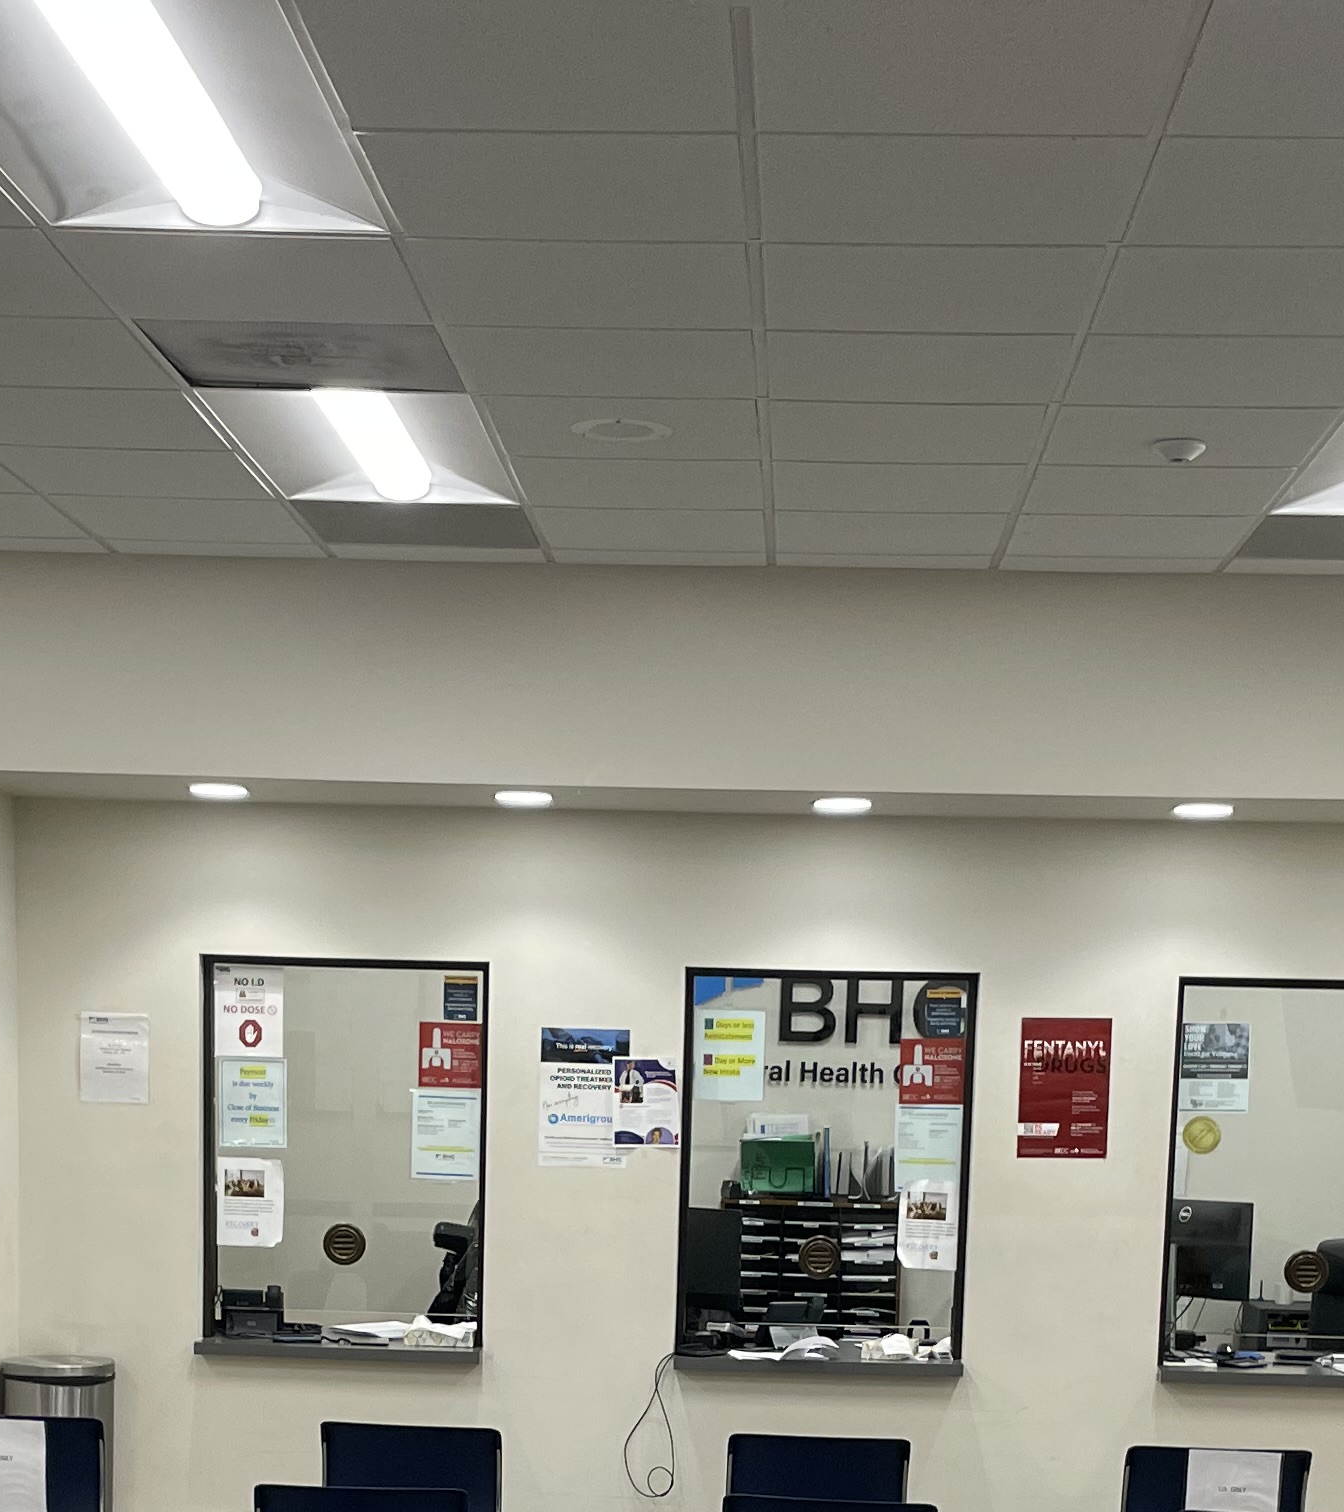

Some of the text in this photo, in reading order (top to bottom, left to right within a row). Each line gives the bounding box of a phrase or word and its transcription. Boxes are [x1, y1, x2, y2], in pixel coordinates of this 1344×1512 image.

[234, 978, 249, 986] NO
[223, 1005, 265, 1014] NO DOSE
[1184, 1034, 1205, 1042] YOUR
[1024, 1040, 1106, 1060] FENTANYL
[1036, 1057, 1106, 1073] DRUGS
[557, 1067, 612, 1075] PERSONALIZED
[800, 1061, 884, 1085] Health
